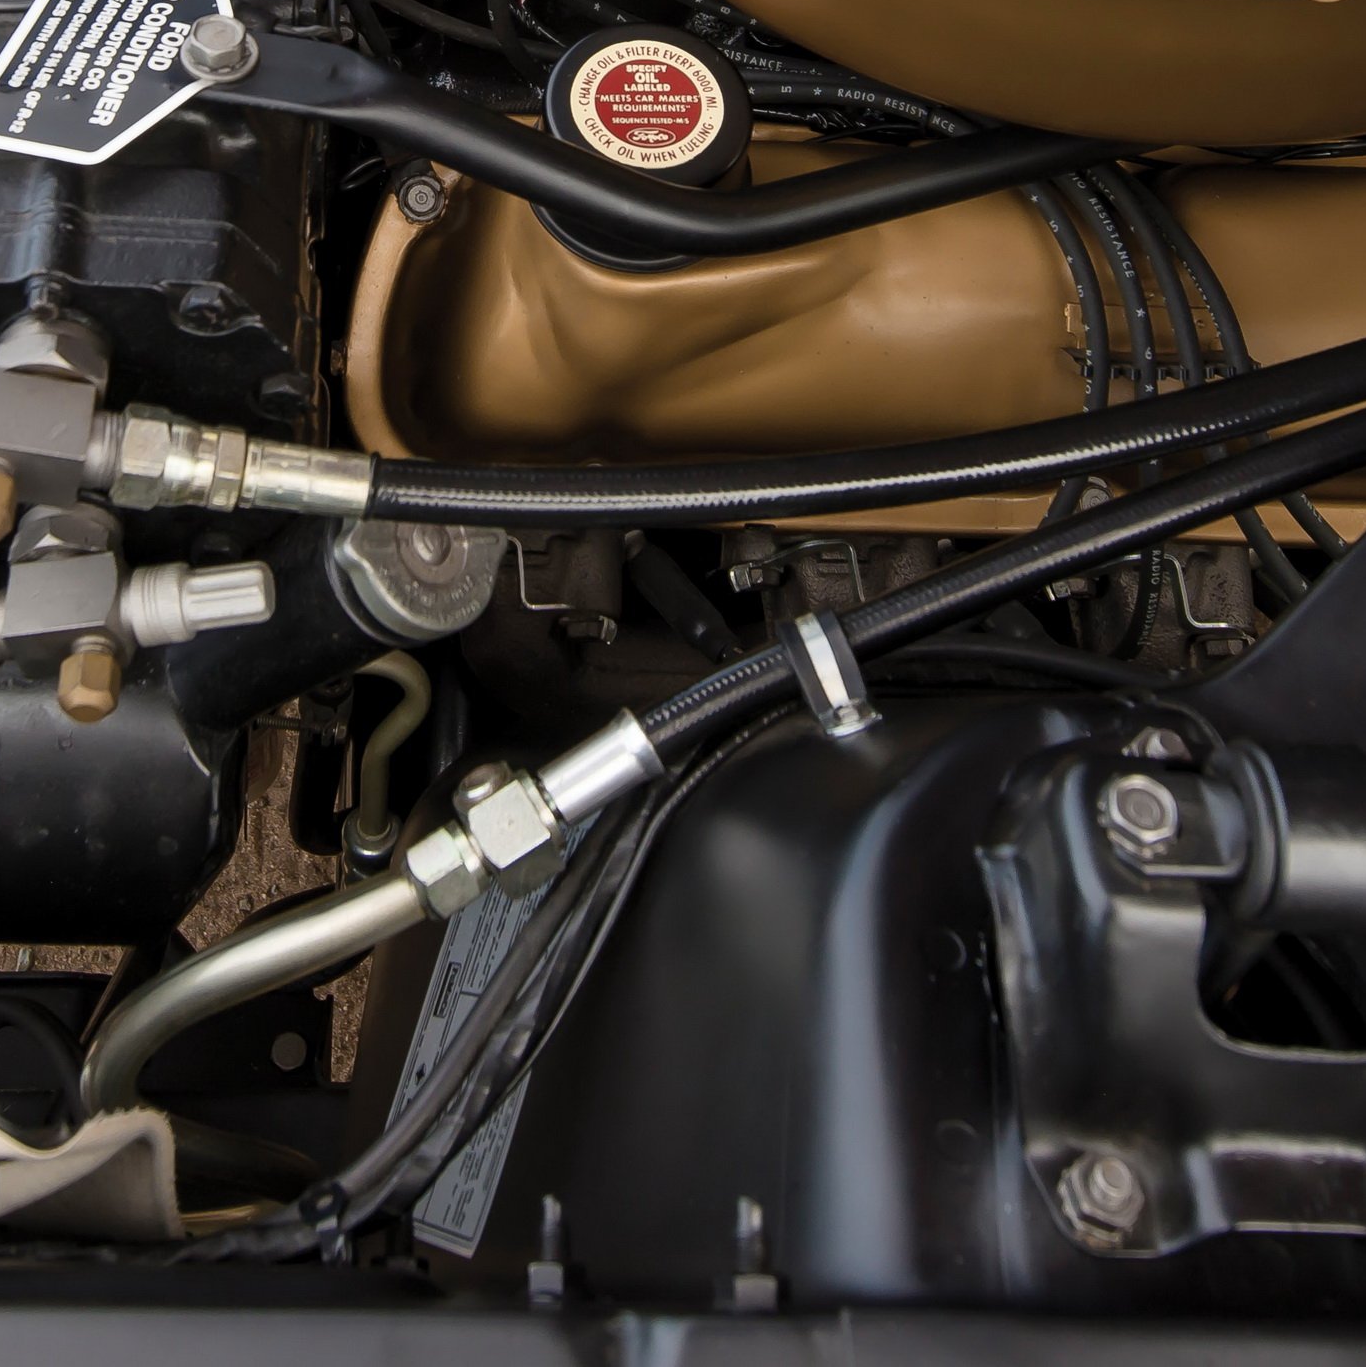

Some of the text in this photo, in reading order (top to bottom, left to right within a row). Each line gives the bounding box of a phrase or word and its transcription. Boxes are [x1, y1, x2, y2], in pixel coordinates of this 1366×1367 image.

[36, 17, 62, 42] WITH
[93, 20, 133, 68] MOTOR
[147, 22, 192, 72] FORD
[57, 51, 91, 87] MICH.
[88, 2, 174, 128] CONDITIONER
[625, 64, 668, 73] SPECIFY
[717, 47, 783, 71] SISTANCE
[79, 67, 106, 92] CO.
[578, 46, 718, 112] CHANGE OIL & FILTER EVERY 6000 MI.
[623, 83, 671, 92] LABELED
[634, 72, 660, 83] OIL
[23, 91, 42, 109] OF
[635, 95, 654, 103] CAR
[837, 88, 875, 103] RADIO
[884, 97, 956, 133] RESISTNCE
[584, 117, 715, 163] CHECK OIL WHEN FUELING
[1088, 197, 1135, 279] RESISTANCE
[1151, 550, 1162, 585] RADIO
